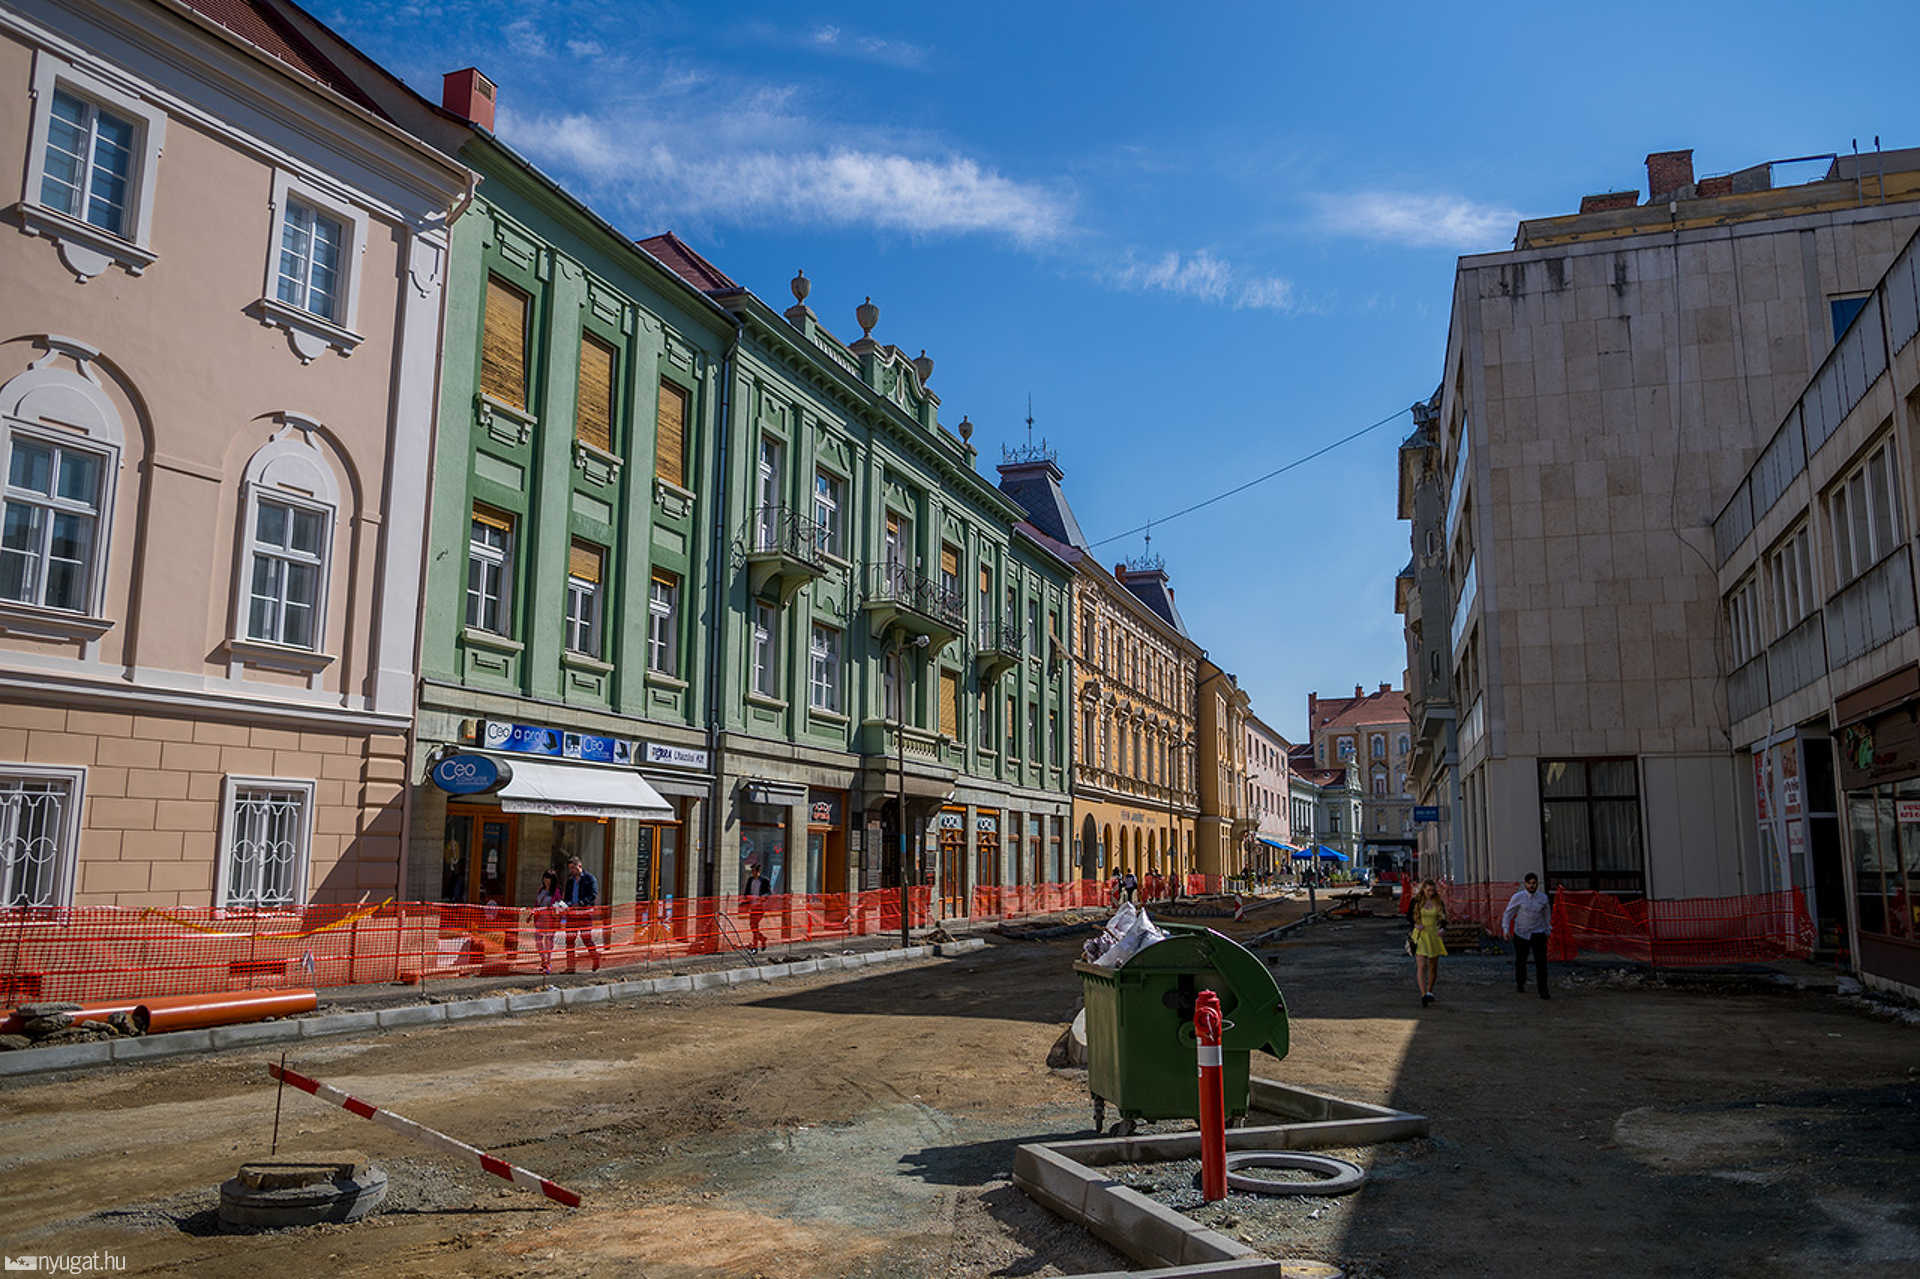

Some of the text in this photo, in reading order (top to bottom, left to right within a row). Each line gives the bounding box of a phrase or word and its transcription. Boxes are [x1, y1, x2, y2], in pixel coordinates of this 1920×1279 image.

[487, 723, 511, 739] Ceo
[514, 729, 547, 741] a profi
[583, 736, 605, 752] Ceo
[440, 760, 476, 780] Ceo
